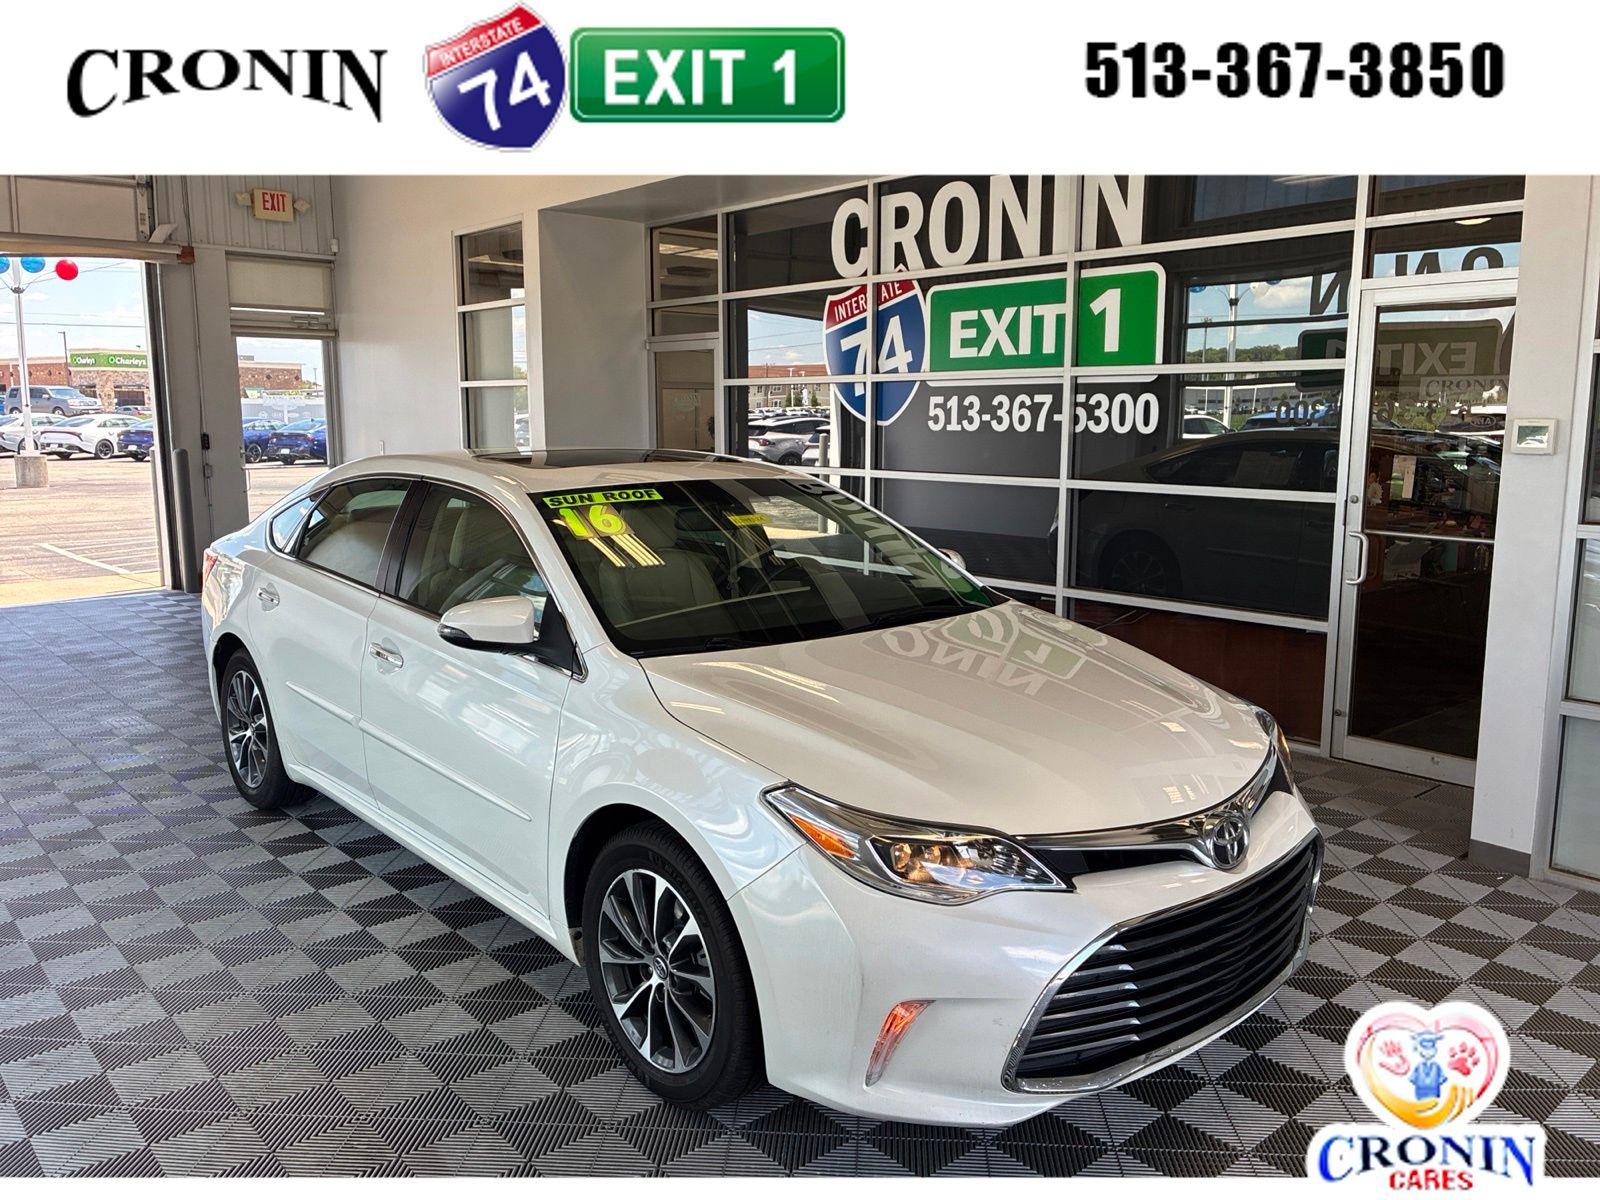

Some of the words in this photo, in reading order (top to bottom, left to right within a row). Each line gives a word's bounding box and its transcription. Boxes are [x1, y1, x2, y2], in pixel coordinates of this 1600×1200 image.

[262, 191, 287, 212] EXIT
[831, 174, 1147, 279] CRONIN
[950, 302, 1068, 359] EXIT
[1089, 288, 1121, 353] 1
[840, 314, 913, 397] 74
[927, 392, 1160, 434] 513-367-5300
[549, 494, 594, 507] SUN
[603, 489, 658, 501] ROOF
[558, 504, 626, 537] 16
